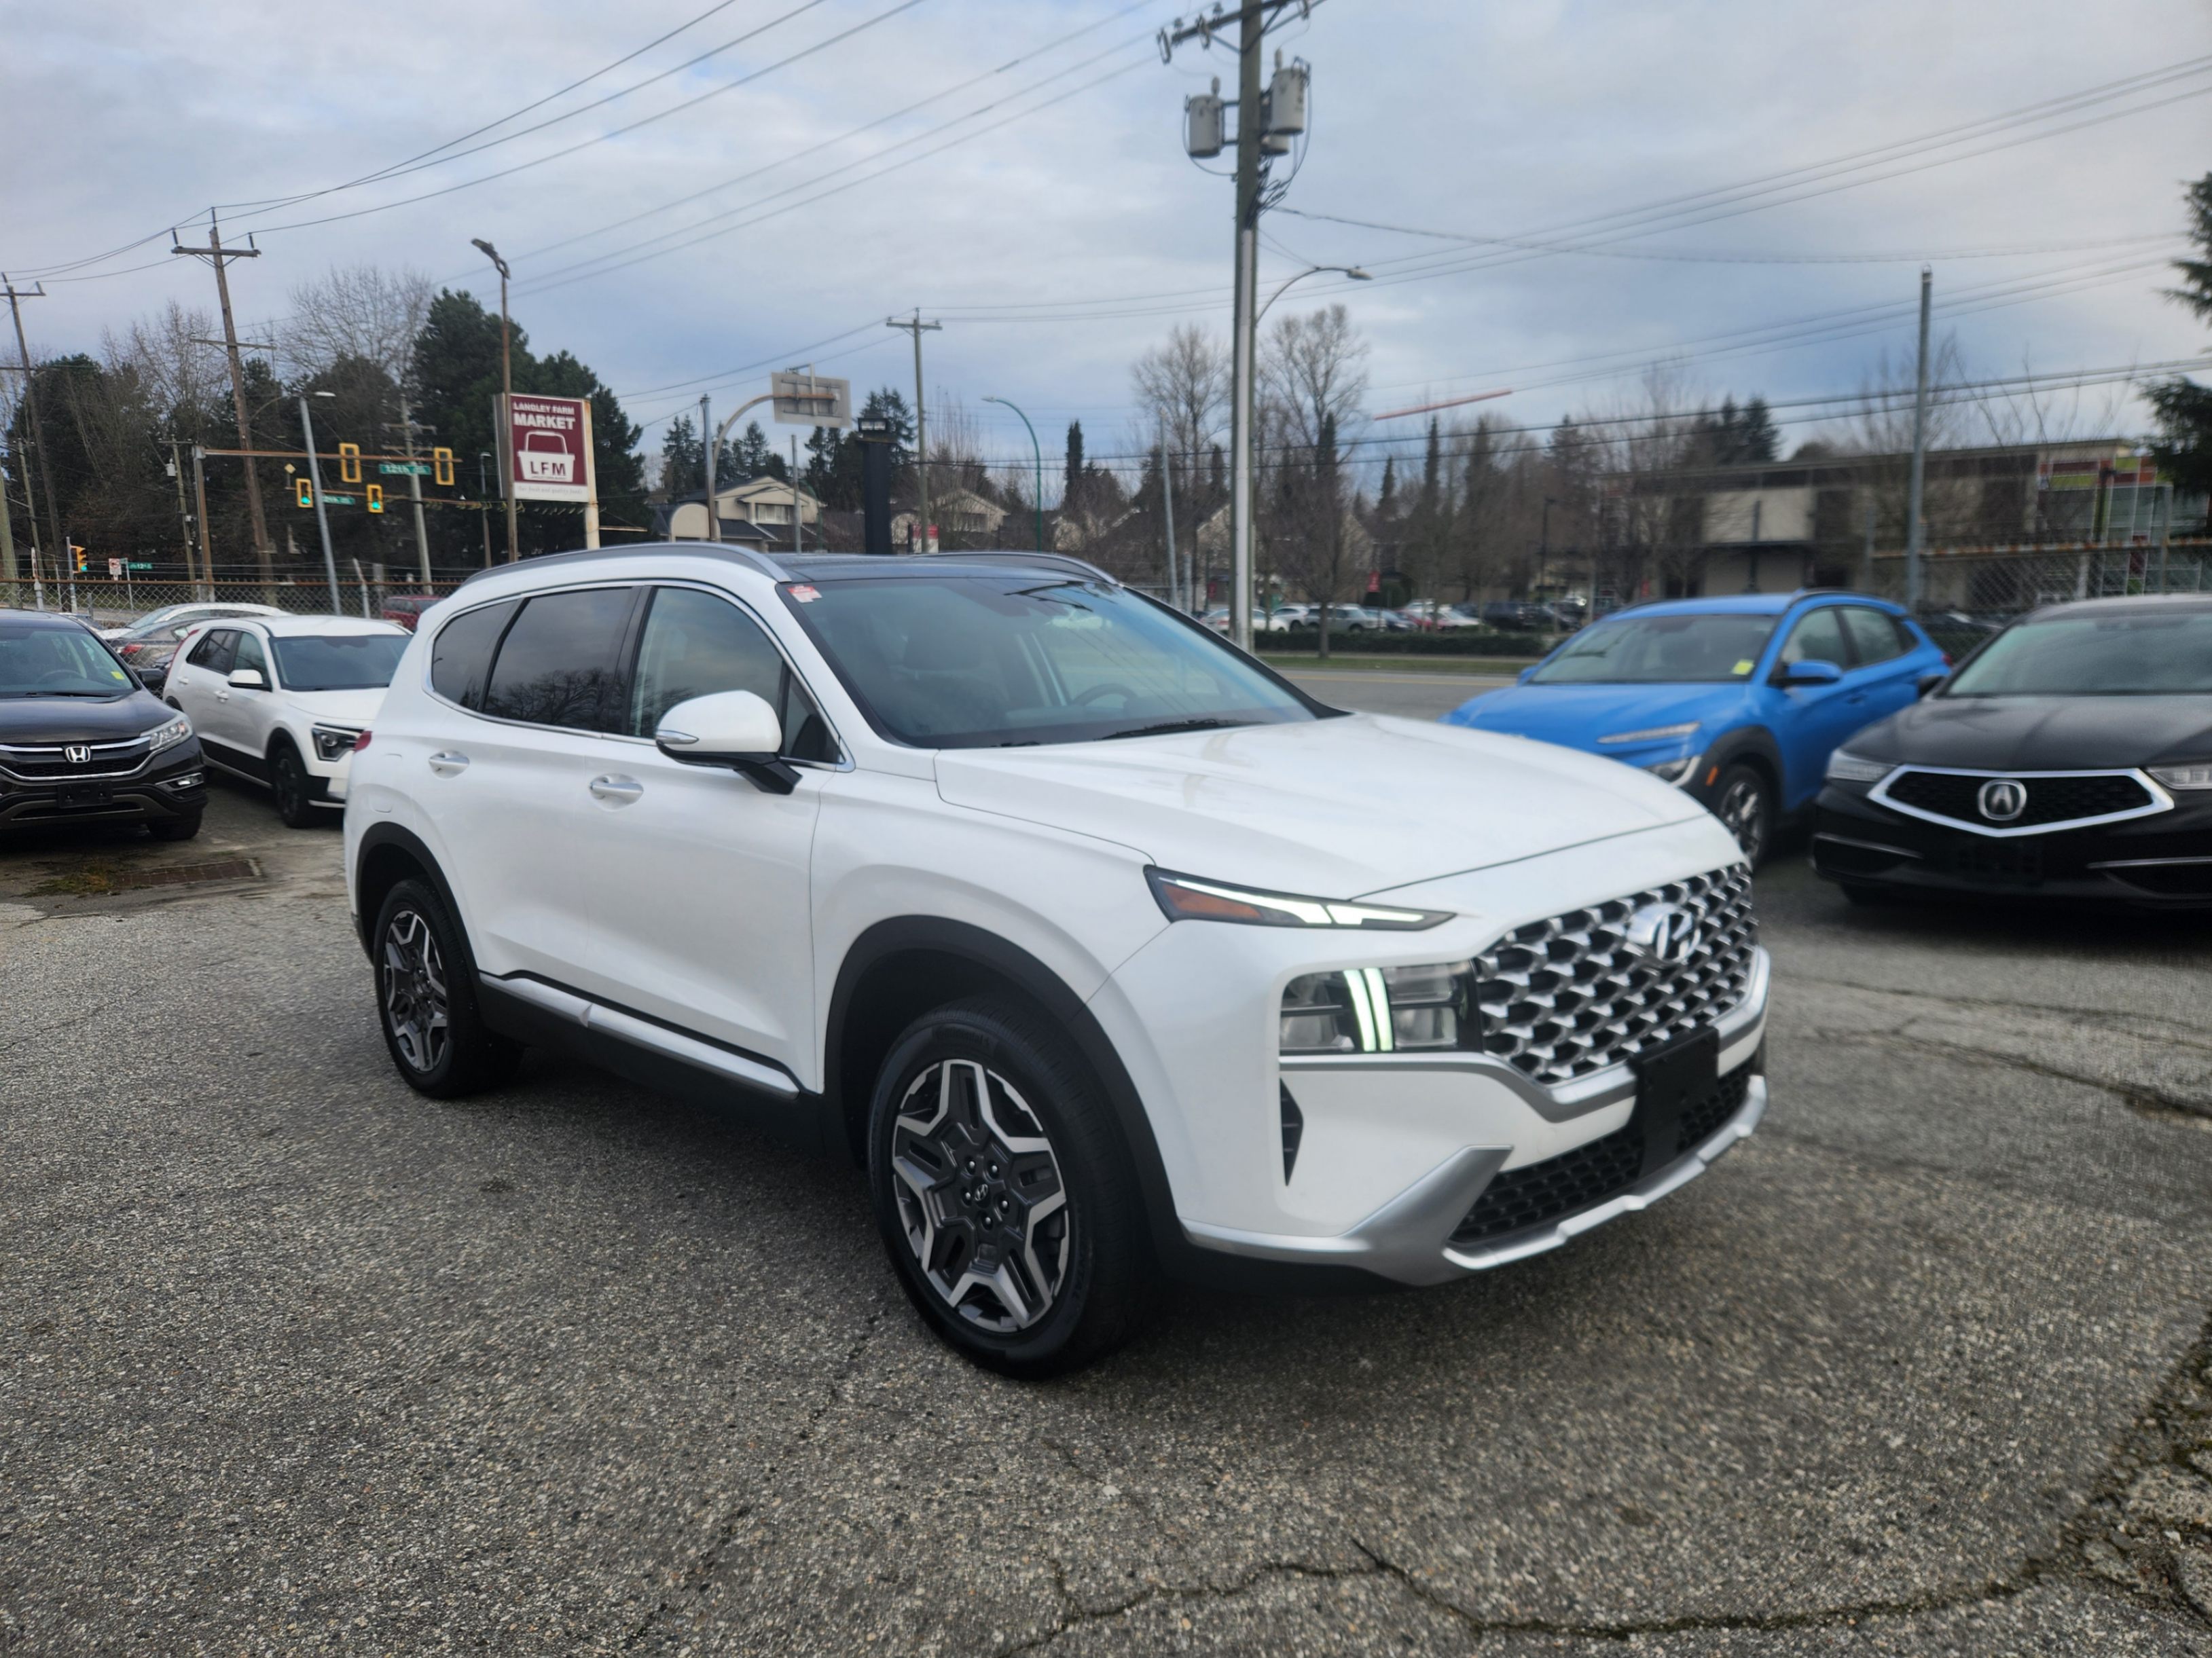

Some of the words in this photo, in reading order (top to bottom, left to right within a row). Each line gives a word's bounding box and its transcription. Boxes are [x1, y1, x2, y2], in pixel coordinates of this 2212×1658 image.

[513, 402, 551, 413] LANGLEY
[552, 406, 575, 415] FARM
[513, 412, 575, 430] MARKET
